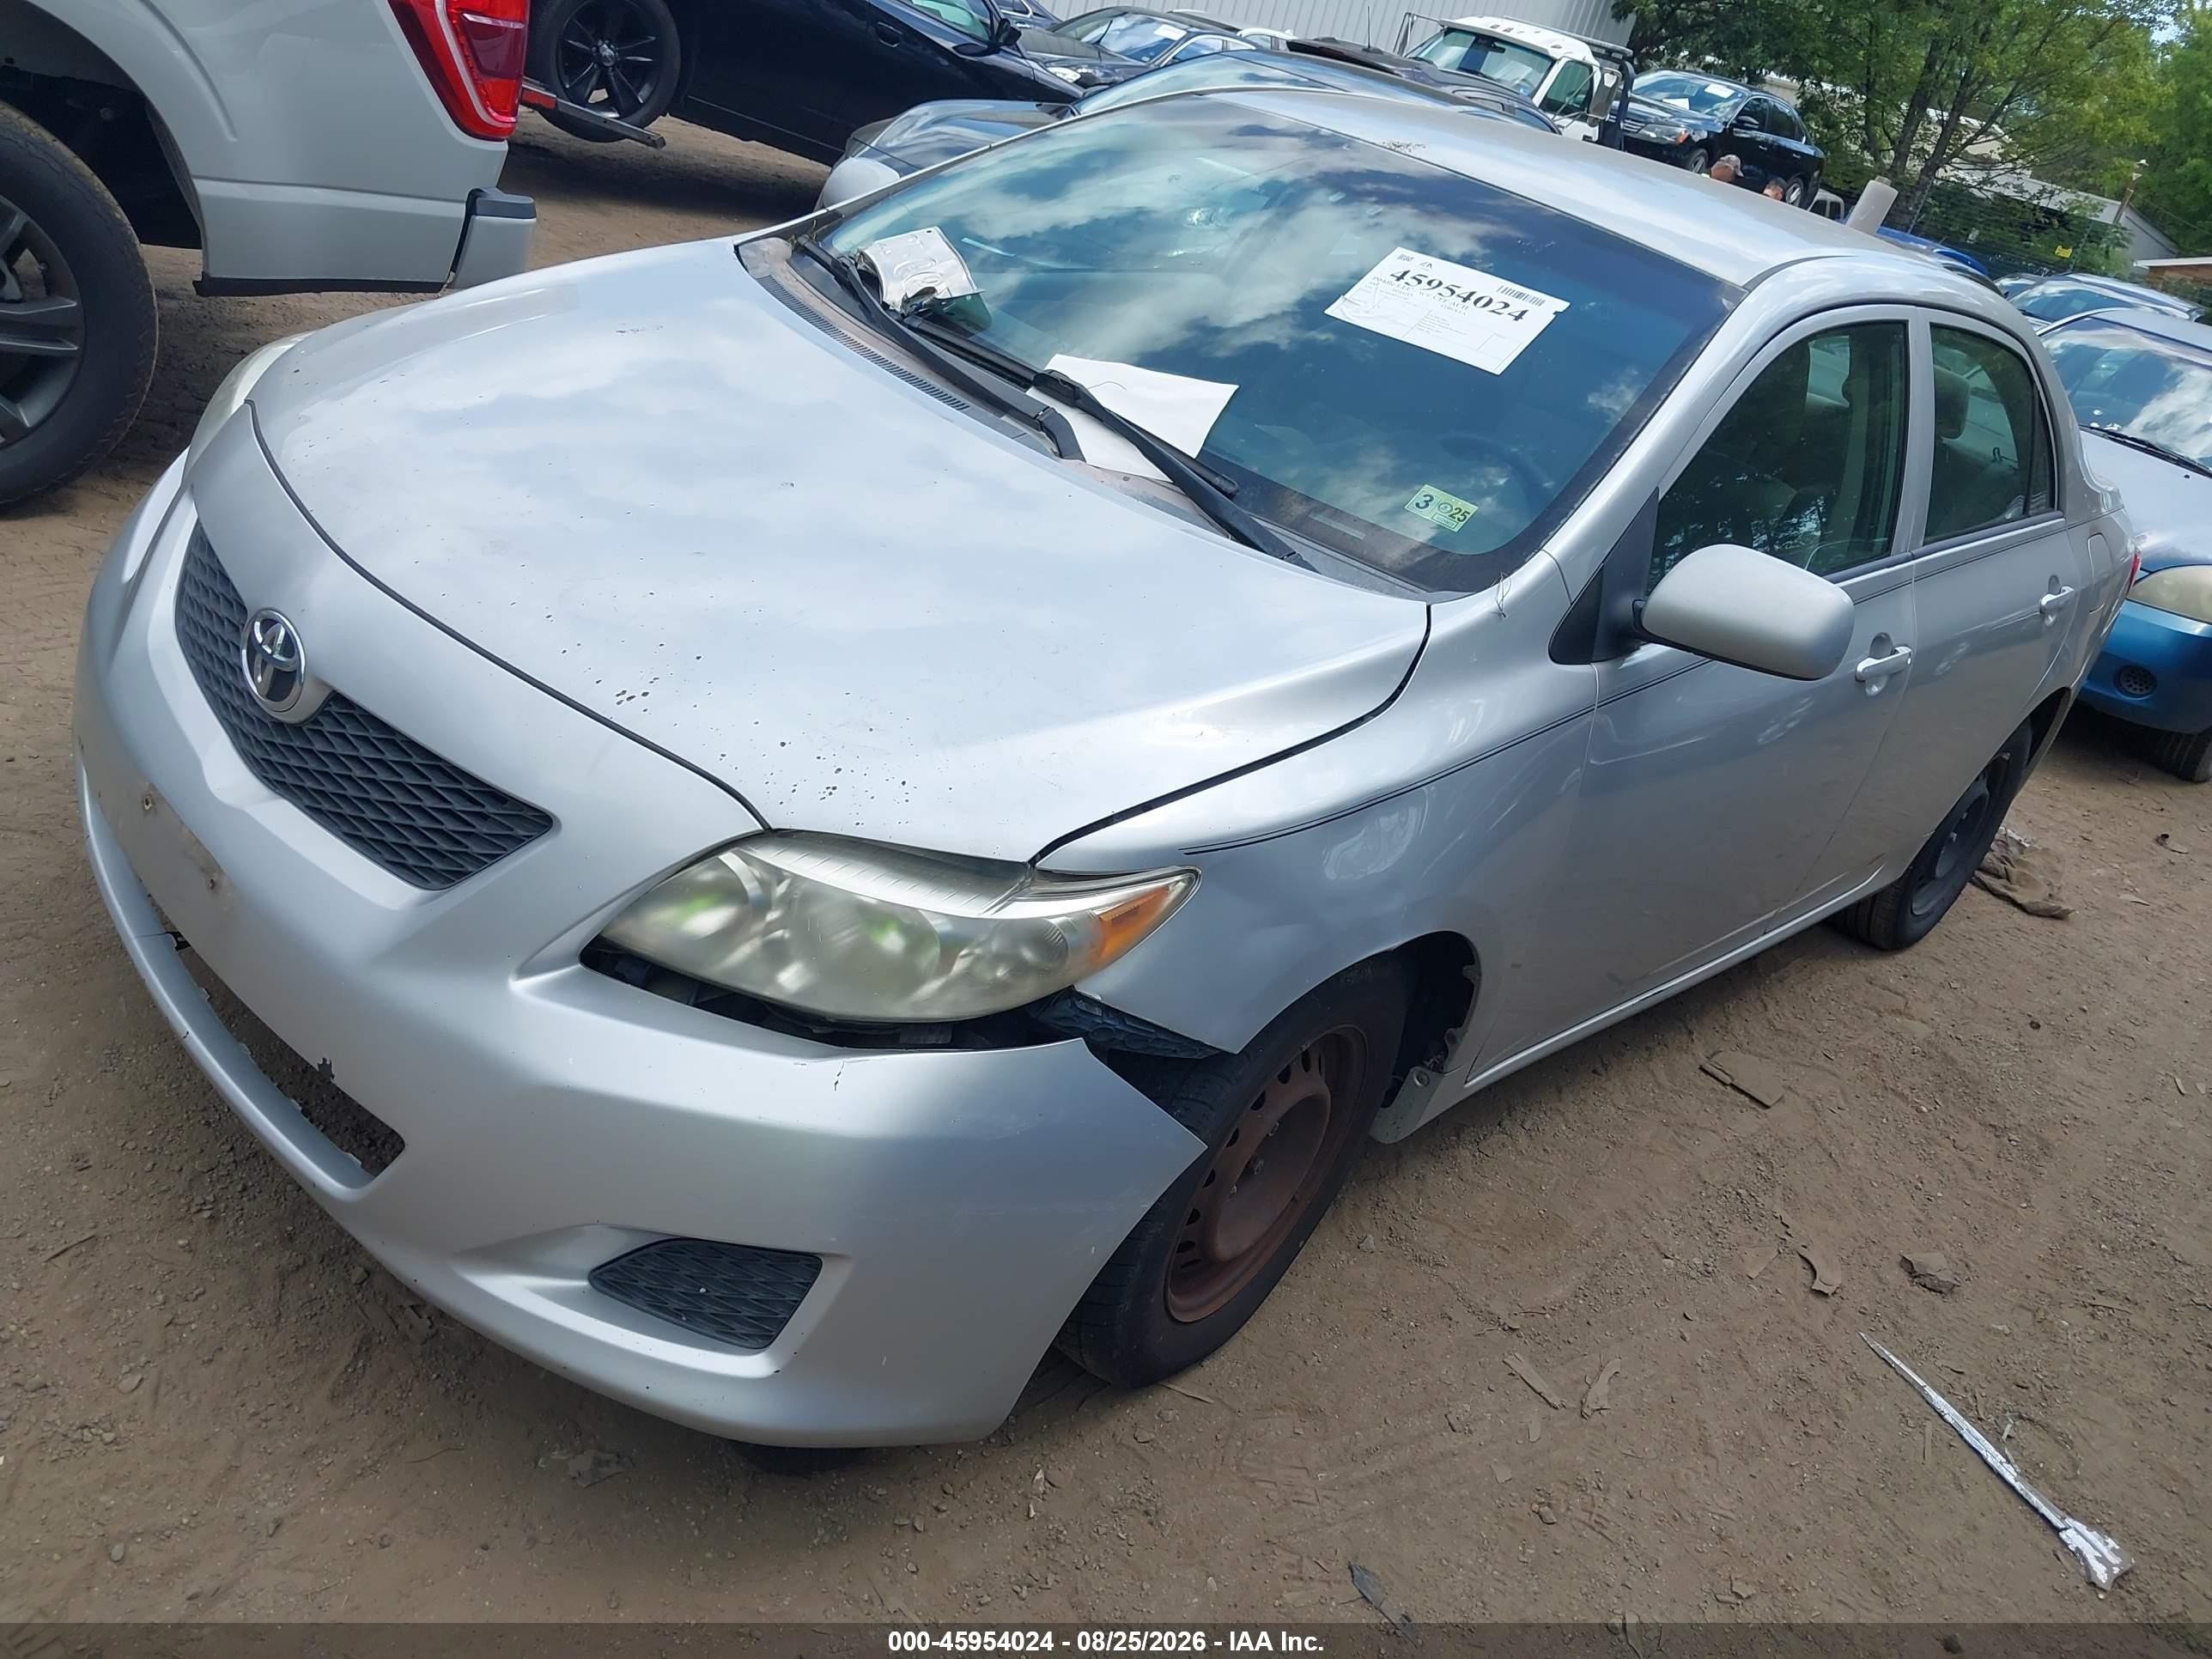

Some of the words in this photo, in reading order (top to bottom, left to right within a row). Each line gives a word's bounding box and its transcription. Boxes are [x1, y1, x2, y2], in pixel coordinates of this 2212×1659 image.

[1389, 269, 1529, 322] 45954024
[1415, 494, 1434, 509] 3
[1448, 507, 1471, 522] 25
